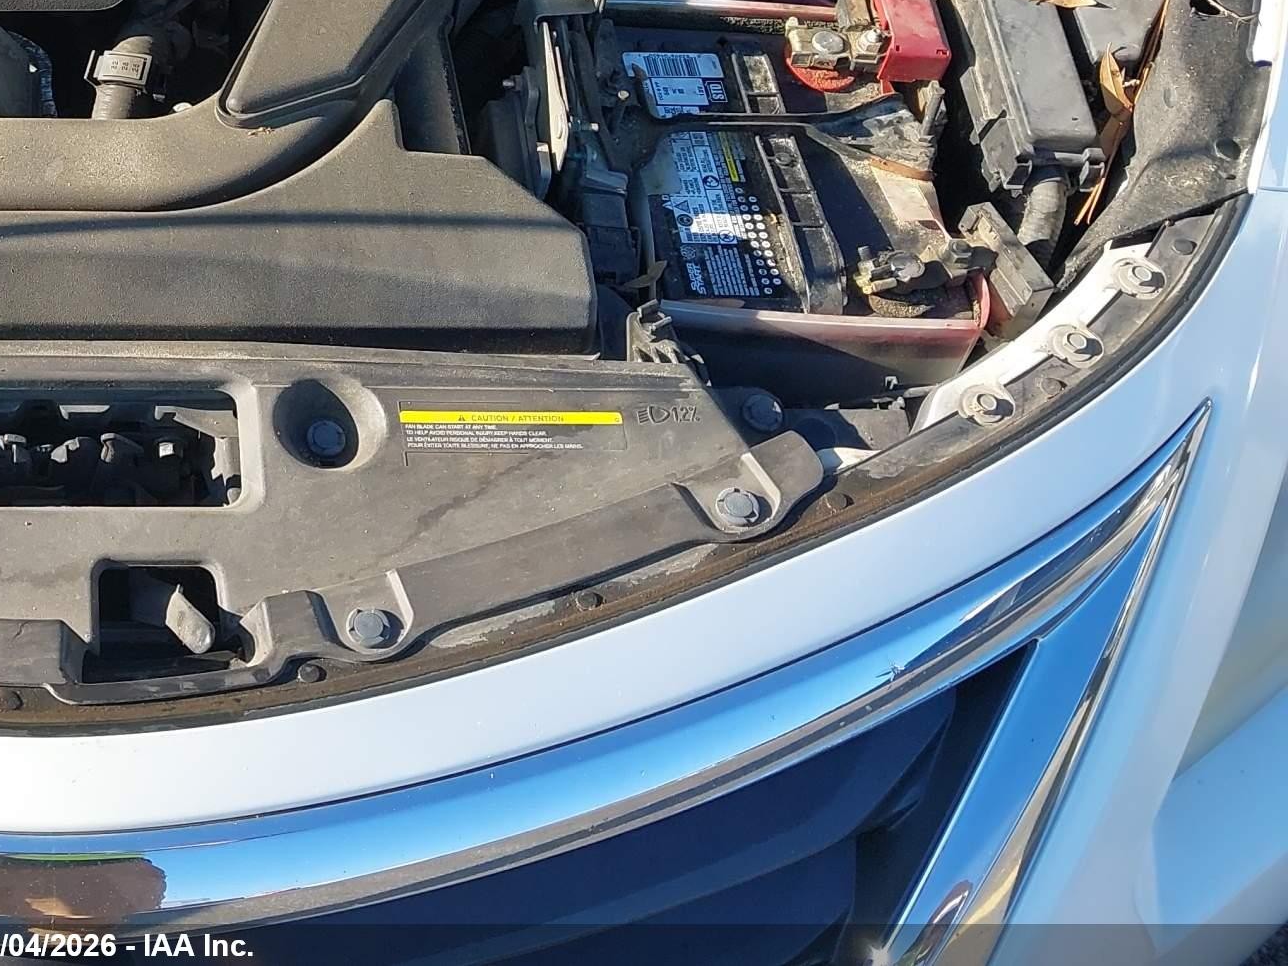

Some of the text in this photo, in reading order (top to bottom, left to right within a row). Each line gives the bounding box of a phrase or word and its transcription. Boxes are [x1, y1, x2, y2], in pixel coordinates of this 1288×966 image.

[686, 263, 697, 290] SUPER
[694, 265, 707, 295] START
[471, 414, 509, 422] CAUTION
[518, 415, 564, 423] ATTENTION
